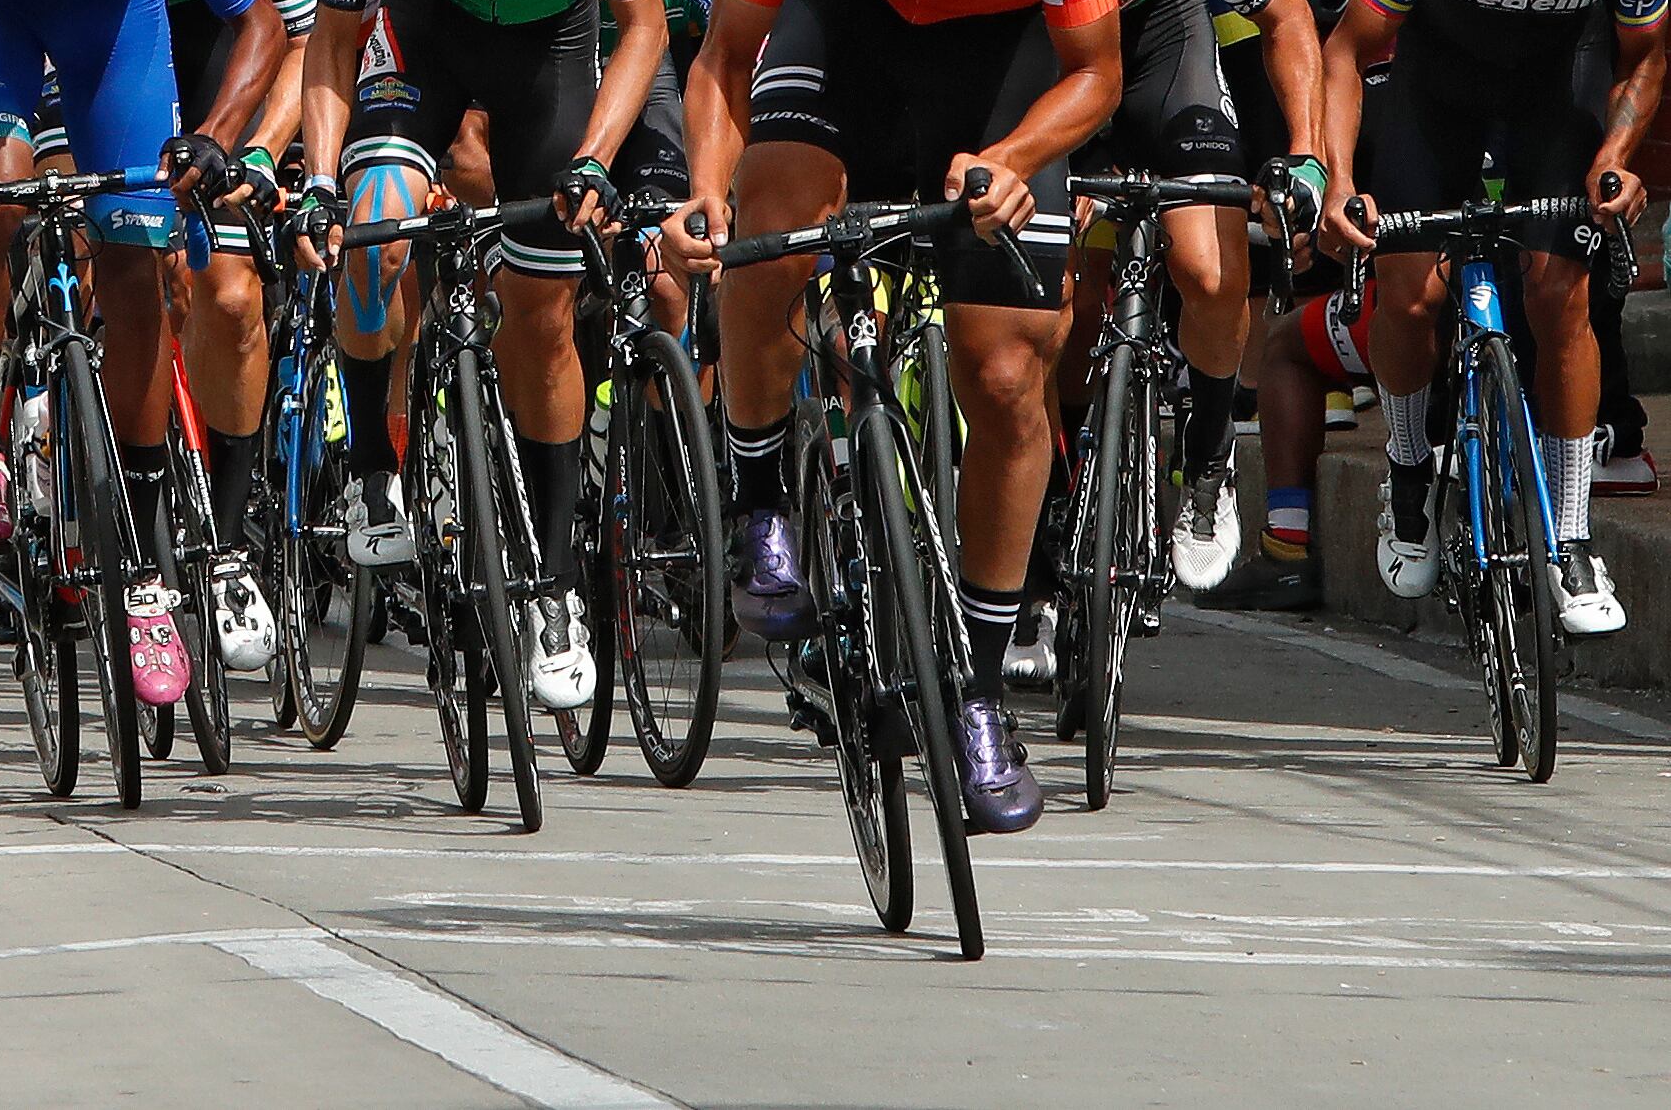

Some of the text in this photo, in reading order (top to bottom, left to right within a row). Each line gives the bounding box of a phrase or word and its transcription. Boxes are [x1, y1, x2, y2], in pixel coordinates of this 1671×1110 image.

[1196, 141, 1231, 151] UNIDOS
[654, 168, 688, 181] UNIDOS
[1574, 225, 1602, 256] ep
